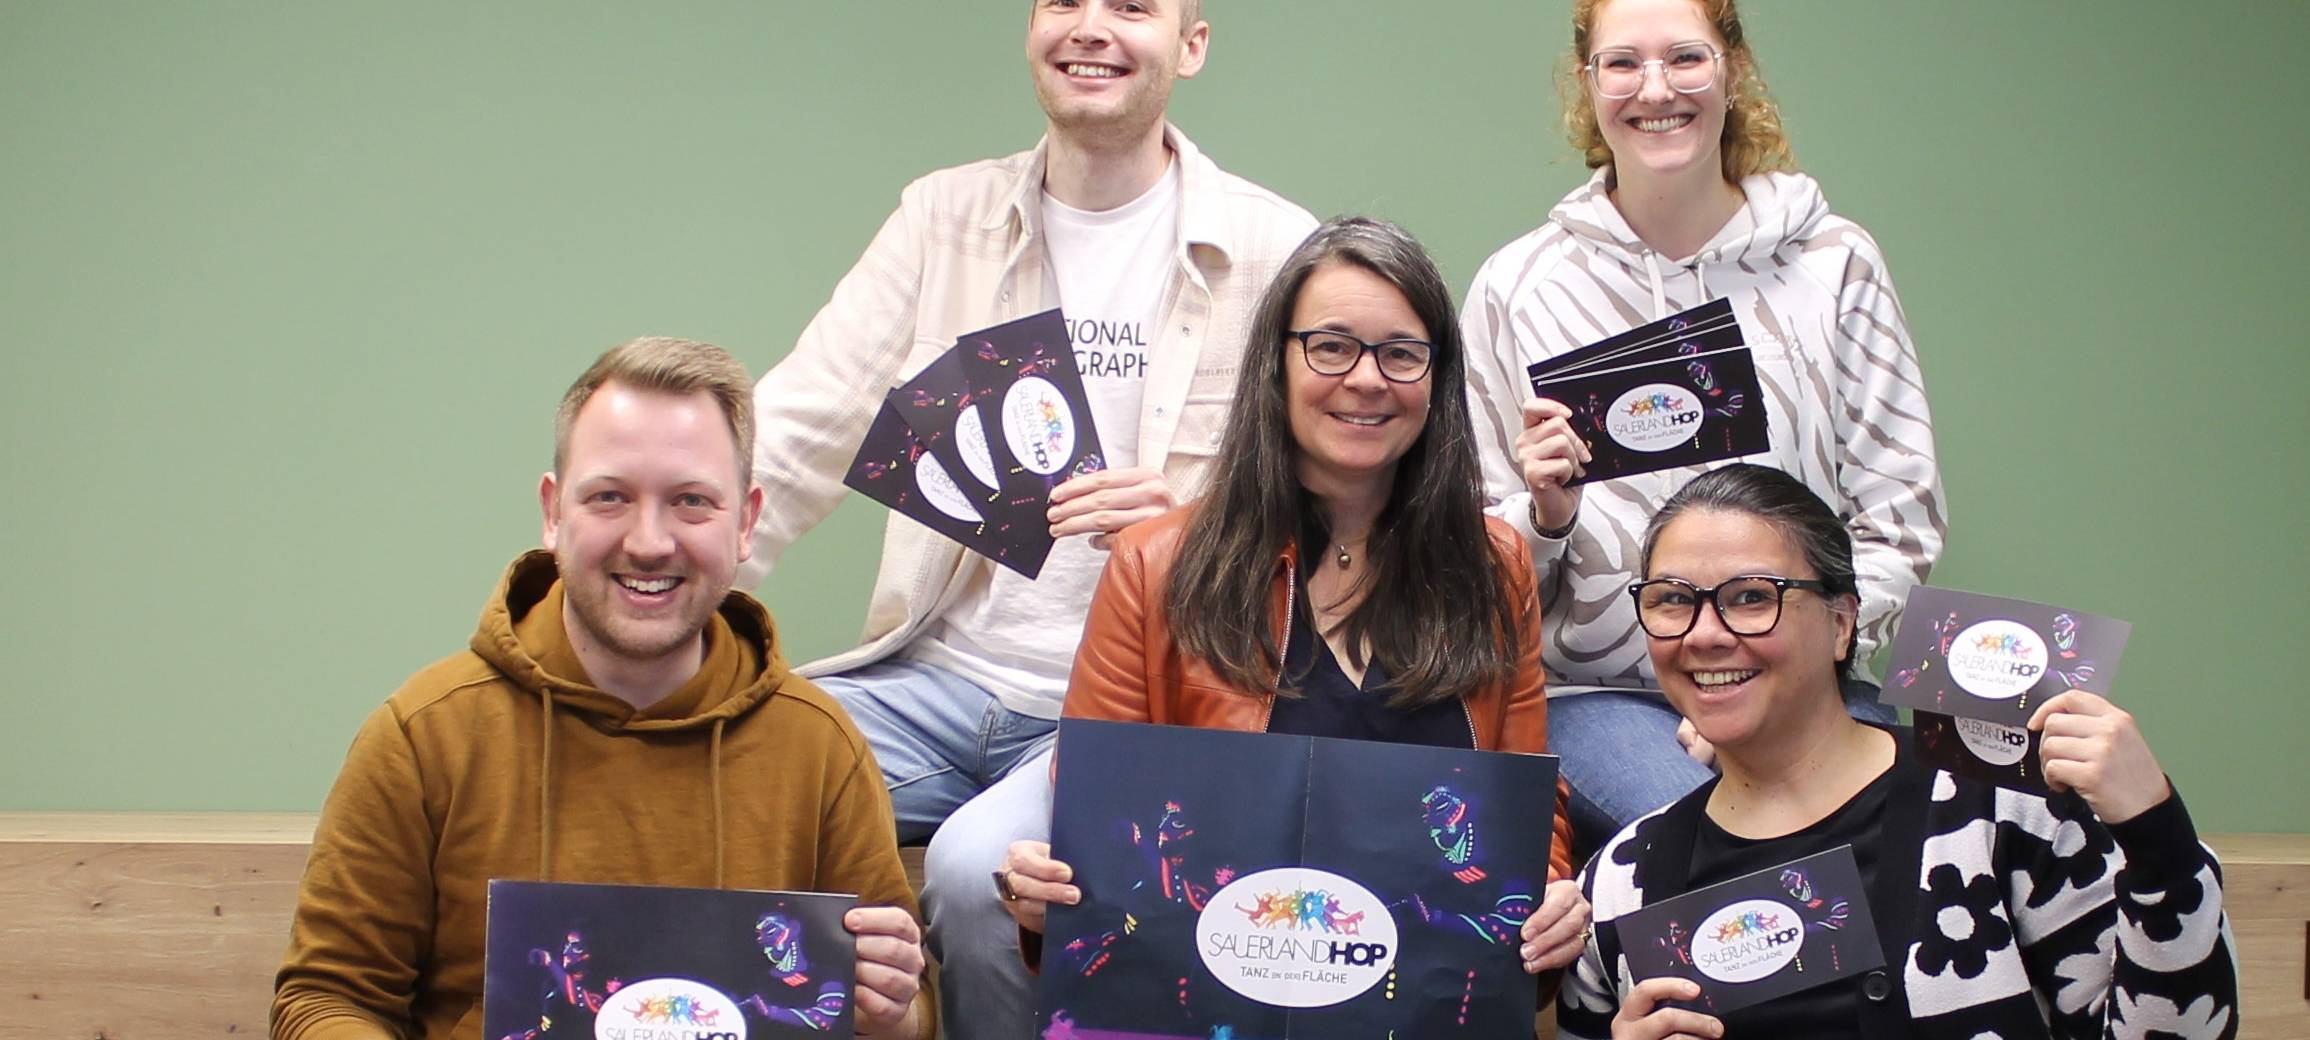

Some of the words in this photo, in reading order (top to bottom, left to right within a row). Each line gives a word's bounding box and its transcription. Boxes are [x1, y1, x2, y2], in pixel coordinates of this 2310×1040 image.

[1064, 319, 1147, 346] IONAL
[1240, 966, 1270, 979] TANZ
[1302, 970, 1348, 984] FLÄCHE
